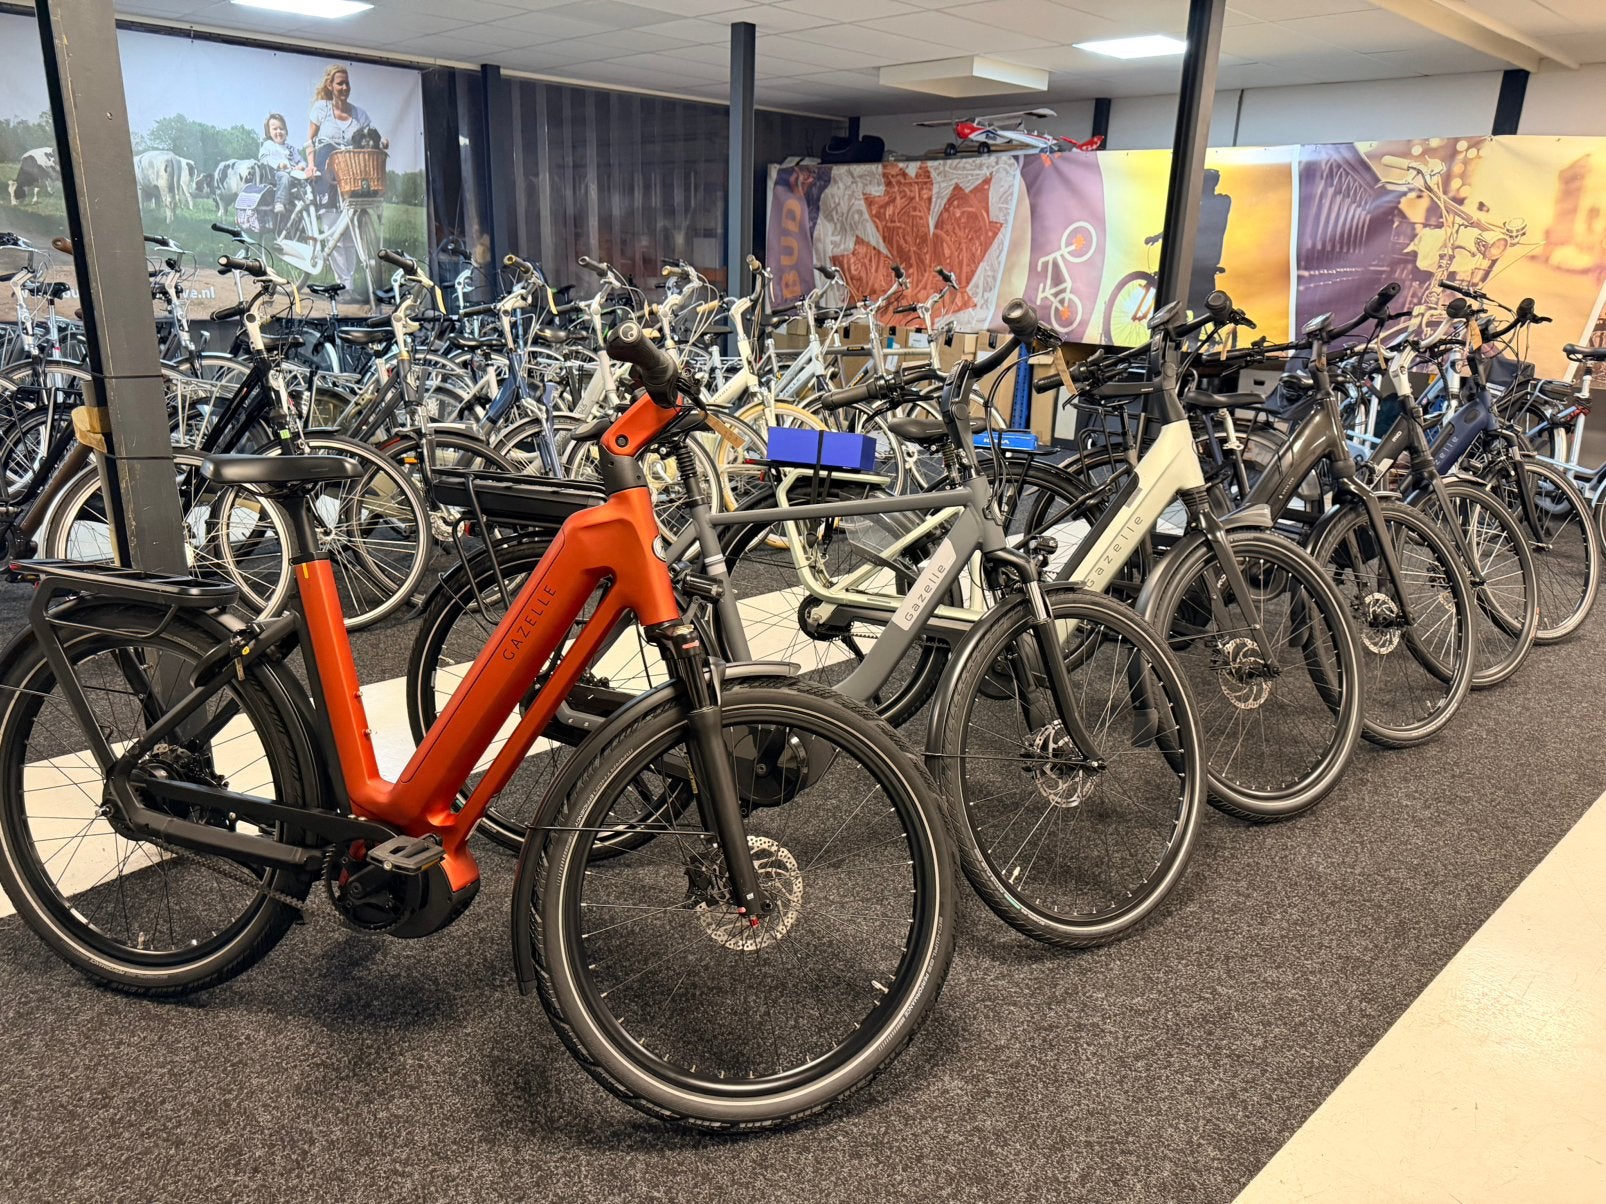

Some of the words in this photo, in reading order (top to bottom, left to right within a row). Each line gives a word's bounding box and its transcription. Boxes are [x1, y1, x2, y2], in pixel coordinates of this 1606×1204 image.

[781, 199, 801, 299] BUD
[183, 286, 216, 299] ve.nl
[1435, 436, 1459, 465] zelle
[1087, 517, 1143, 588] Gazelle
[905, 565, 946, 621] Gazelle
[503, 585, 556, 660] GAZELLE
[904, 973, 930, 1017] PERFORMANCE
